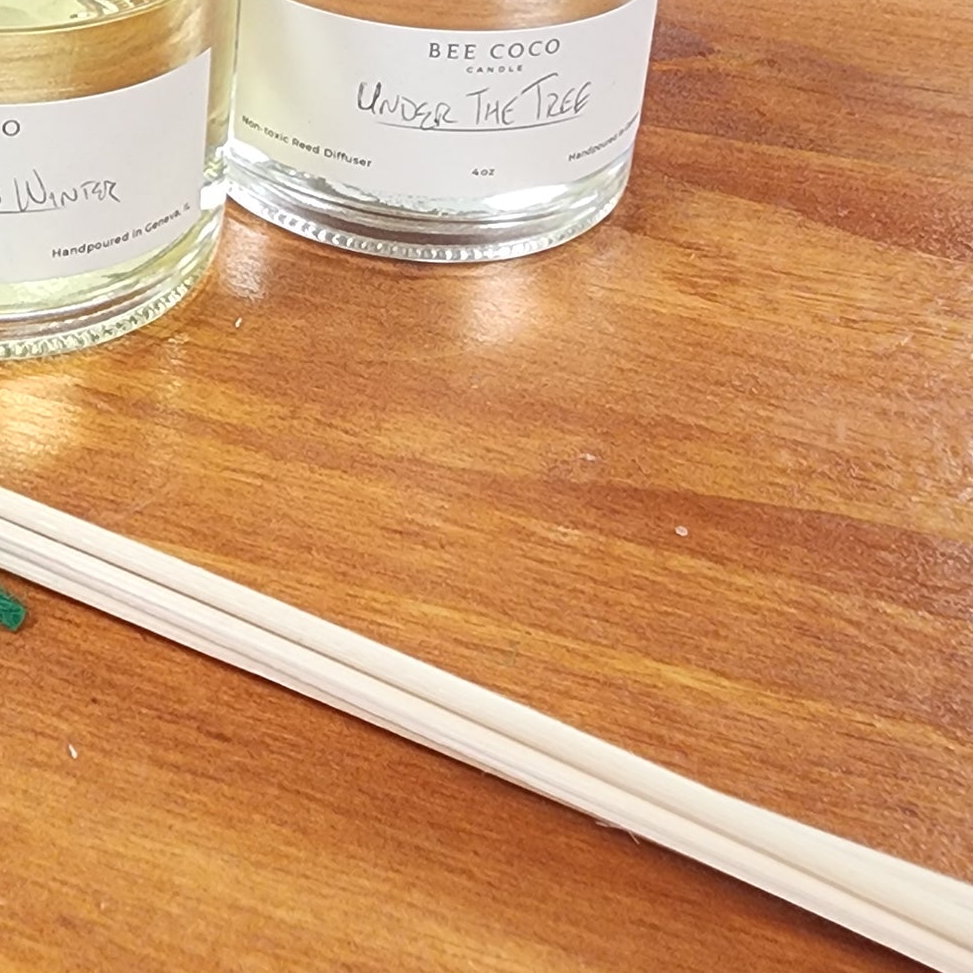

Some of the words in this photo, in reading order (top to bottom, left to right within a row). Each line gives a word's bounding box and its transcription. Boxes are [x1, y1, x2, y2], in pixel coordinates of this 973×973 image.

[428, 42, 476, 60] BEE
[489, 38, 560, 60] COCO
[466, 64, 523, 74] CANDLE
[242, 115, 289, 144] Non-toxic
[291, 137, 320, 154] Reed
[323, 148, 372, 167] Diffuser
[471, 167, 495, 177] 4oz
[52, 232, 129, 258] Handpoured
[132, 228, 143, 238] in
